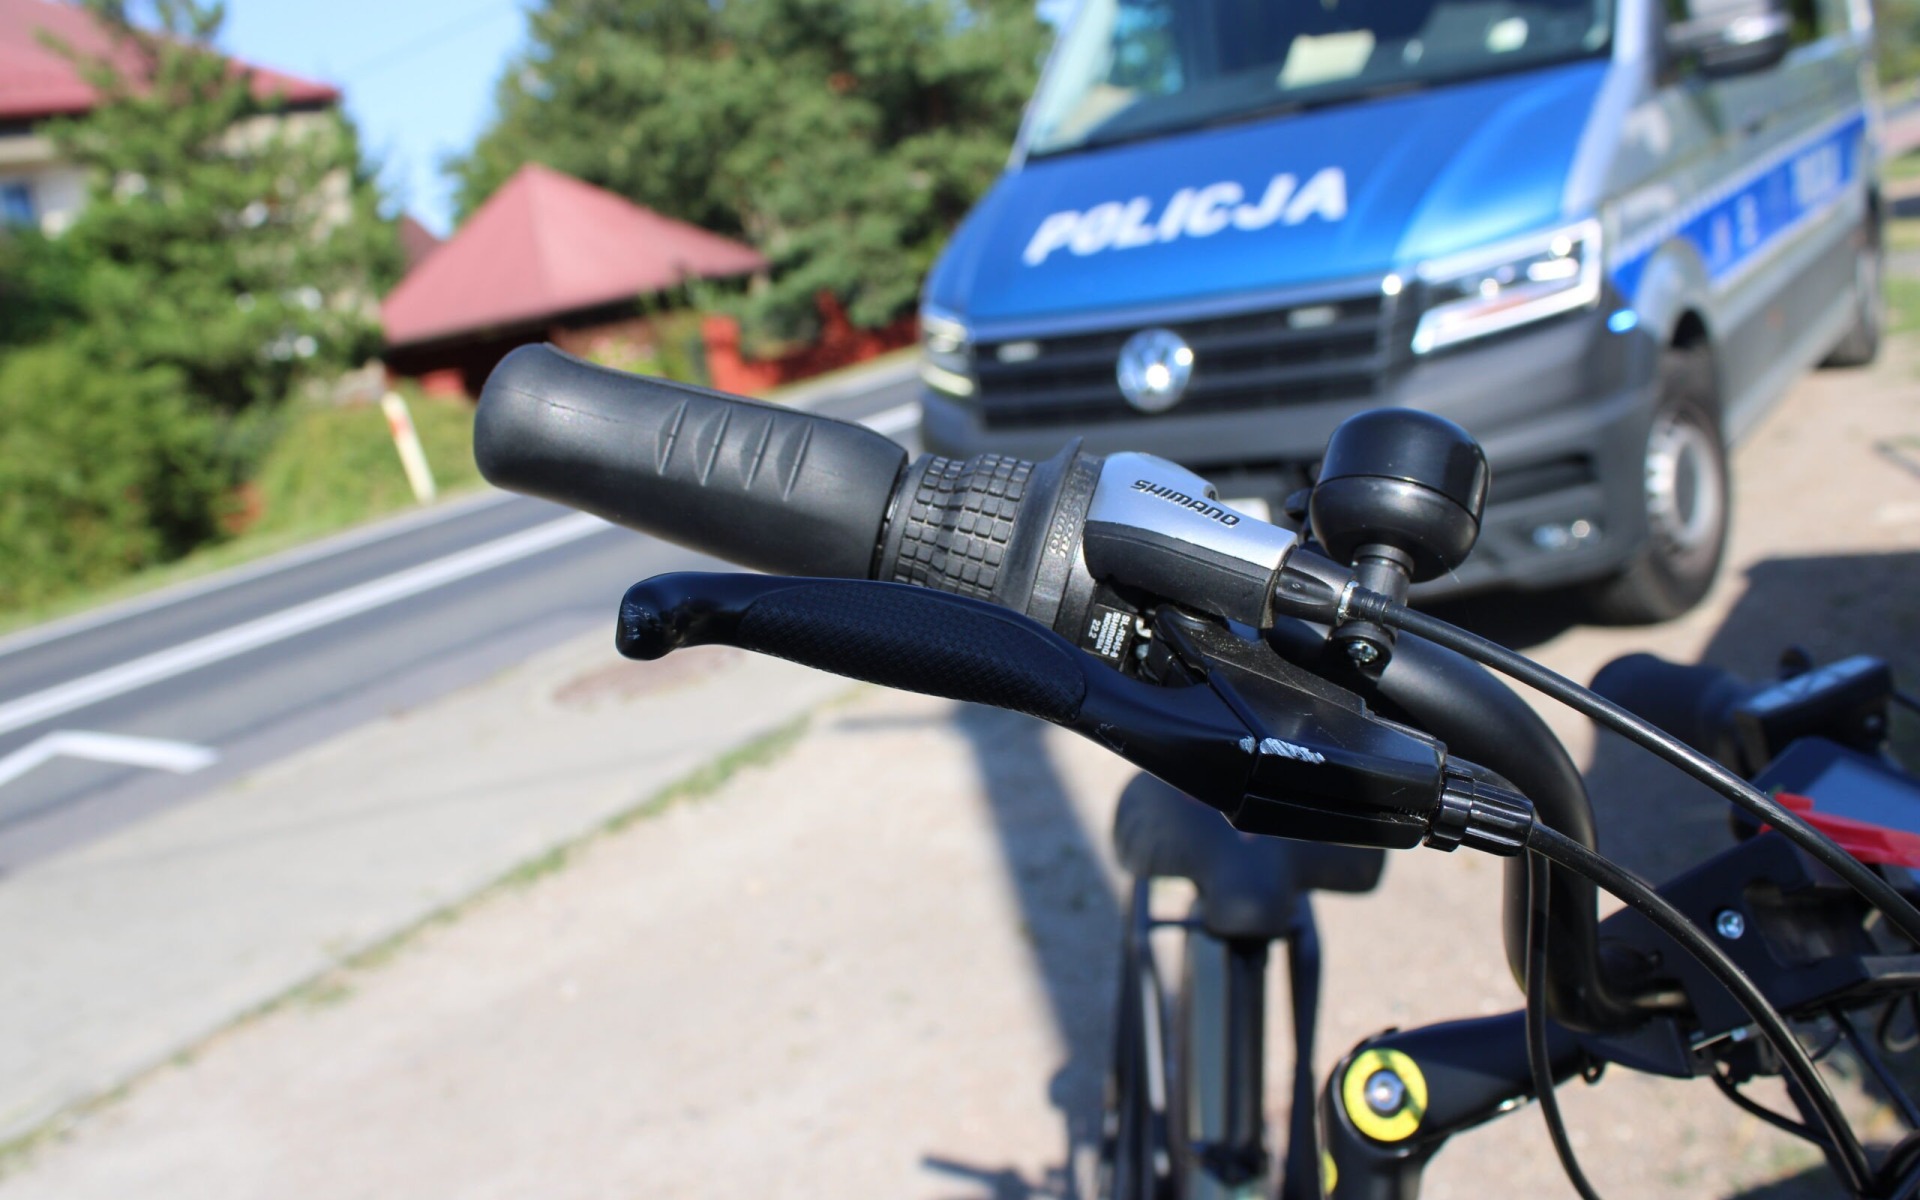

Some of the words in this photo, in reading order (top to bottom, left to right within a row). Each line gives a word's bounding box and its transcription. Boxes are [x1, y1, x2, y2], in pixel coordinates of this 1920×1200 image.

[1023, 166, 1348, 267] POLICJA
[1131, 480, 1240, 526] SHIMANO
[1088, 619, 1101, 639] 22.2
[1095, 612, 1112, 649] INDONESIA
[1101, 612, 1121, 655] SHIMANO
